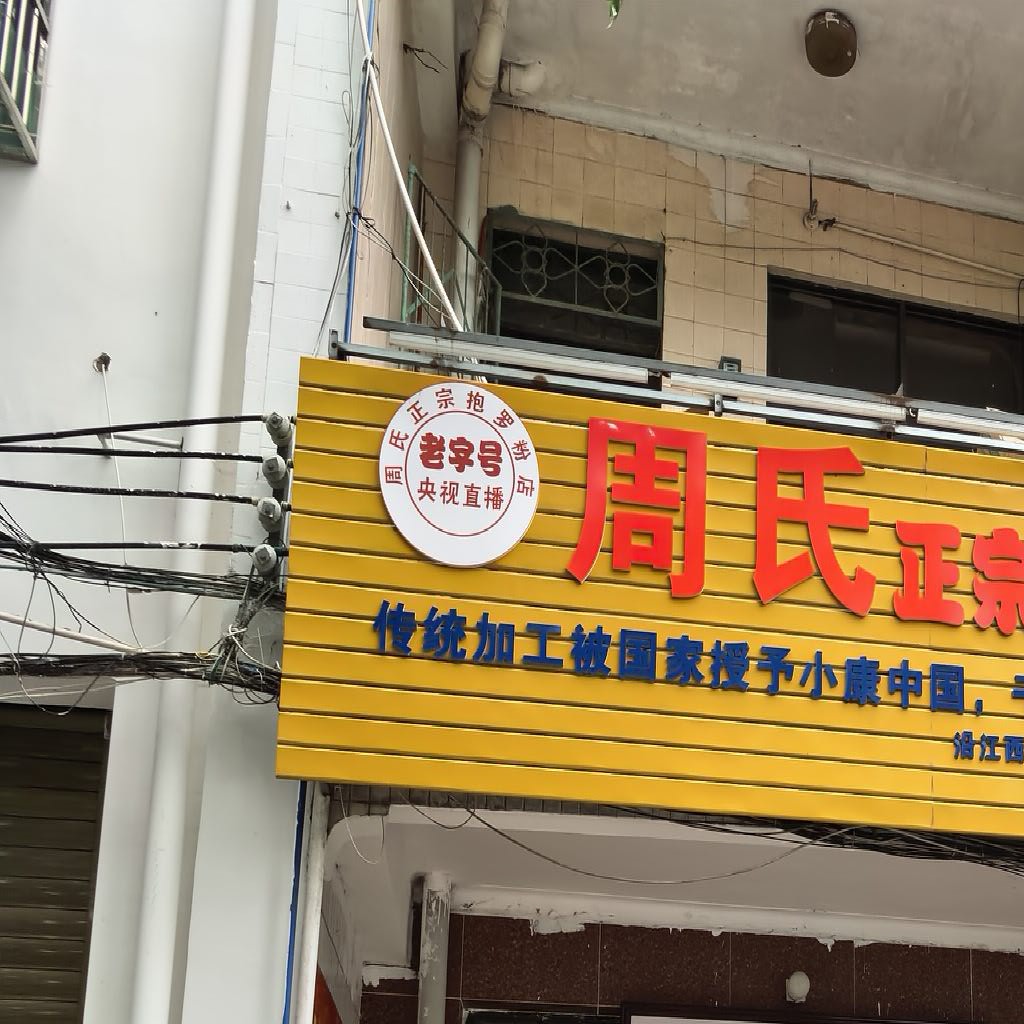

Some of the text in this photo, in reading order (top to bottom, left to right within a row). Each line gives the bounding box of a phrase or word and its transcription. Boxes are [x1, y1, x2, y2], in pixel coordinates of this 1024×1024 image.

[385, 388, 535, 498] 周氏正宗抱罗粉店
[419, 432, 503, 477] 老字号
[417, 476, 504, 510] 央视直播
[566, 416, 876, 617] 周氏
